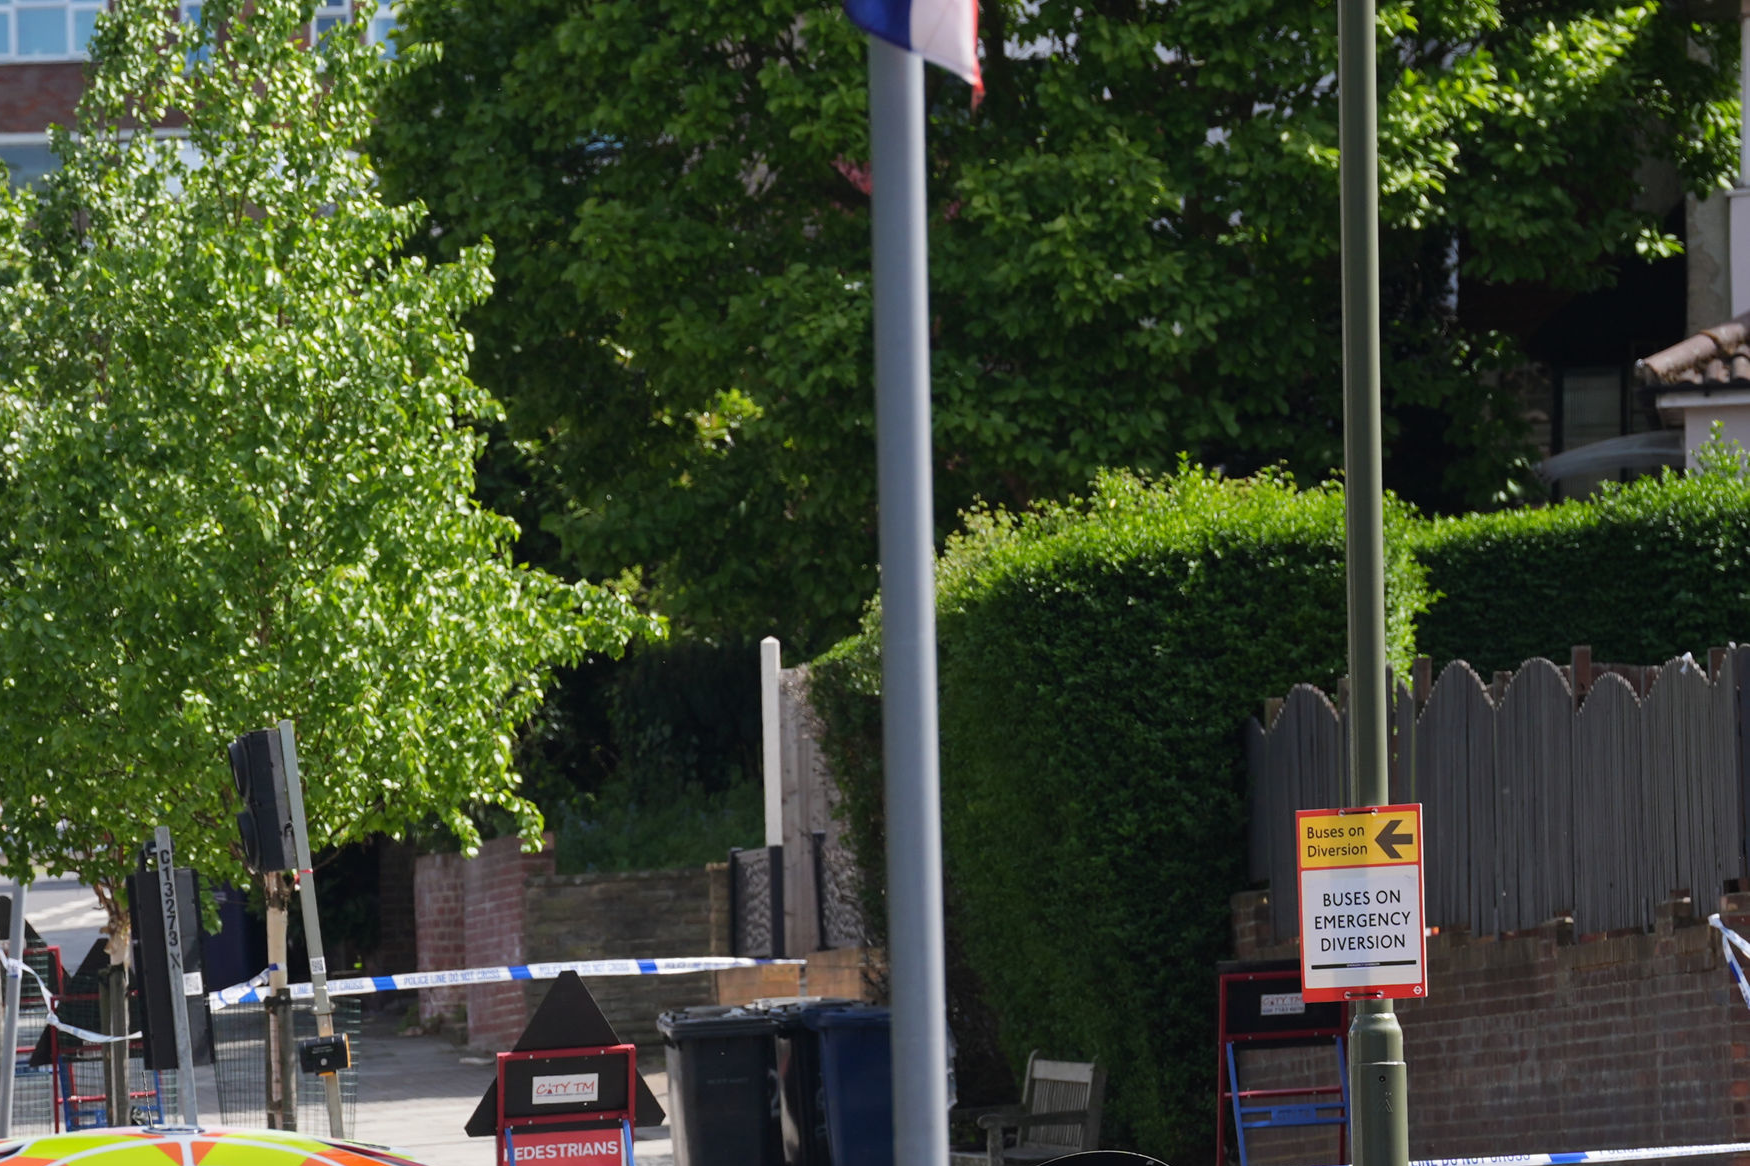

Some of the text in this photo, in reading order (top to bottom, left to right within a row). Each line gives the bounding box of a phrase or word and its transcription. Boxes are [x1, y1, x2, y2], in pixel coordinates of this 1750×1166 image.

[1306, 825, 1365, 839] Buses on
[1307, 843, 1368, 858] Diversion
[1323, 889, 1401, 907] BUSES ON
[1314, 911, 1411, 930] EMERGENCY
[1321, 934, 1406, 952] DIVERSION
[338, 979, 364, 991] CROSS
[403, 974, 429, 986] POLICE
[430, 973, 447, 984] LINE
[460, 970, 475, 982] NOT
[476, 968, 500, 981] CROSS
[573, 1080, 596, 1093] TM
